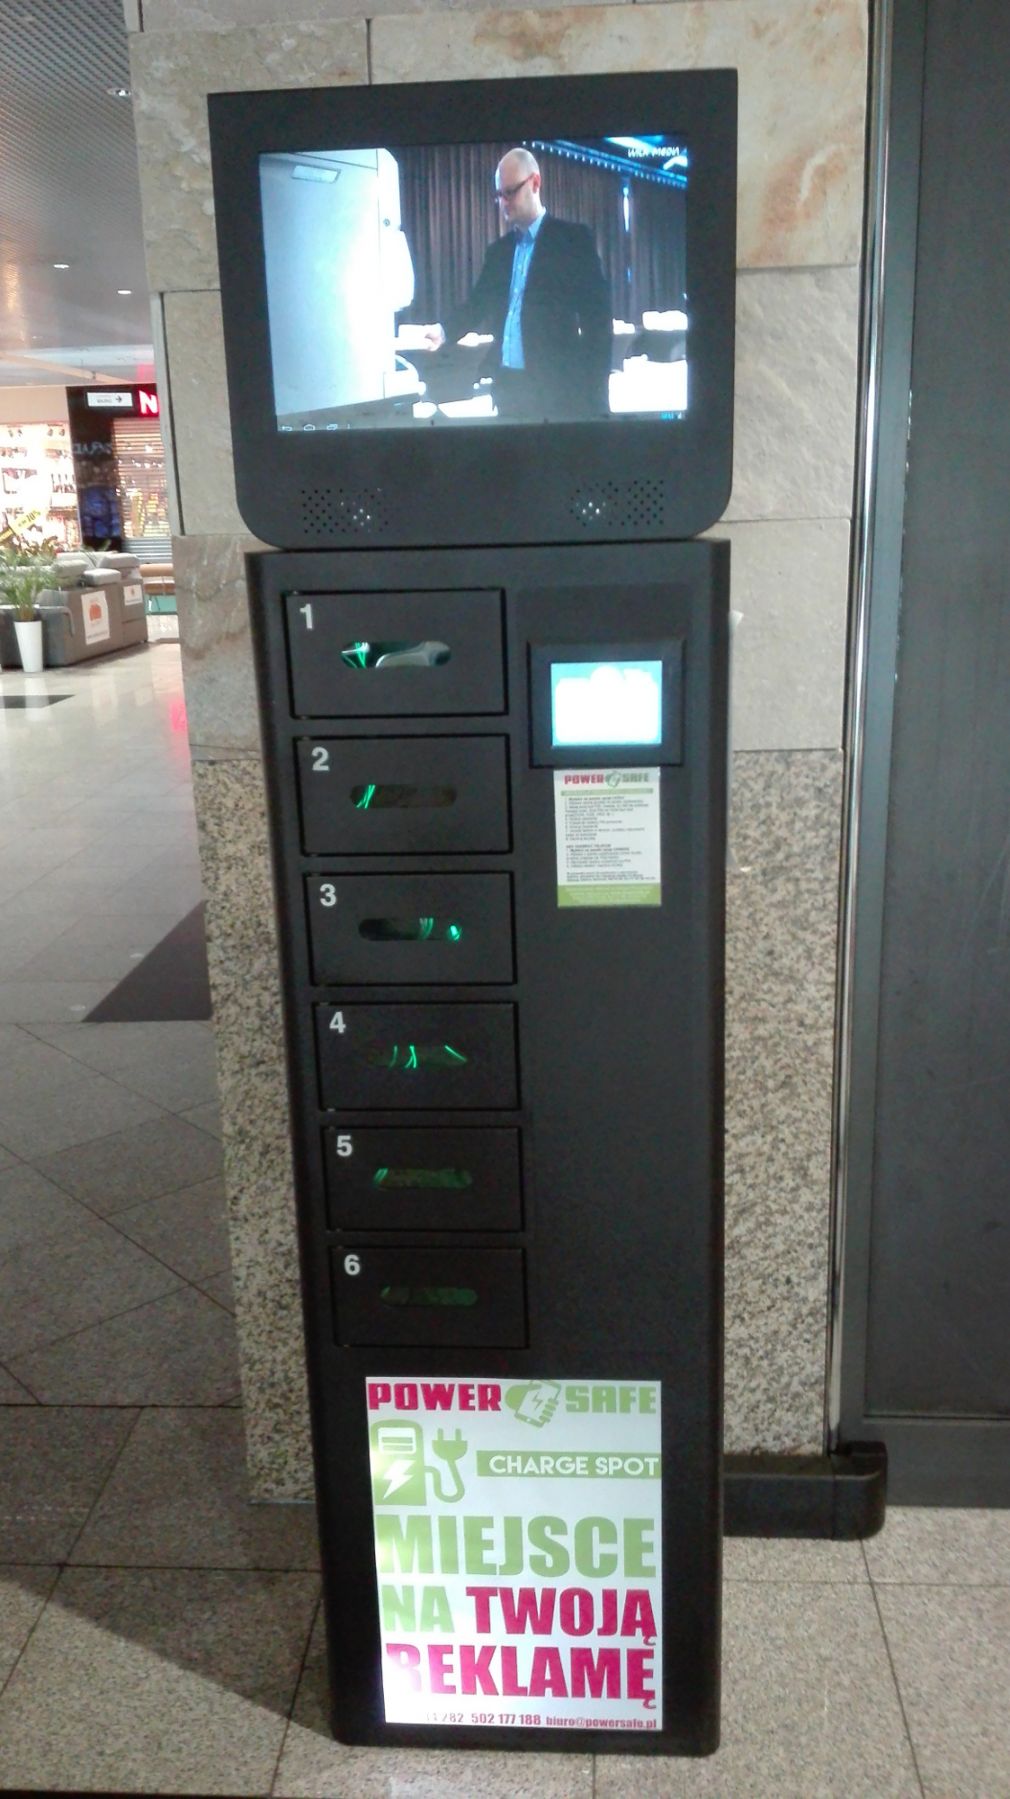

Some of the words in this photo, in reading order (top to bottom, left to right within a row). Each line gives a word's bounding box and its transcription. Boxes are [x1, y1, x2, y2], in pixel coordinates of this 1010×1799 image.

[300, 604, 313, 629] 1
[312, 747, 330, 771] 2
[564, 774, 604, 784] POWER
[622, 773, 649, 783] SAFE
[320, 883, 337, 906] 3
[329, 1012, 346, 1033] 4
[336, 1135, 353, 1157] 5
[344, 1254, 361, 1275] 6
[368, 1383, 501, 1411] POWER
[565, 1385, 657, 1414] SAFE
[489, 1455, 588, 1475] CHARGE
[595, 1457, 659, 1476] SPOT
[375, 1514, 657, 1578] MIEJSCE
[381, 1584, 455, 1633] NA
[466, 1586, 658, 1646] TWOJĄ
[386, 1643, 657, 1709] REKLAMĘ
[471, 1713, 495, 1724] 502
[498, 1714, 517, 1725] 177
[519, 1714, 542, 1726] 188
